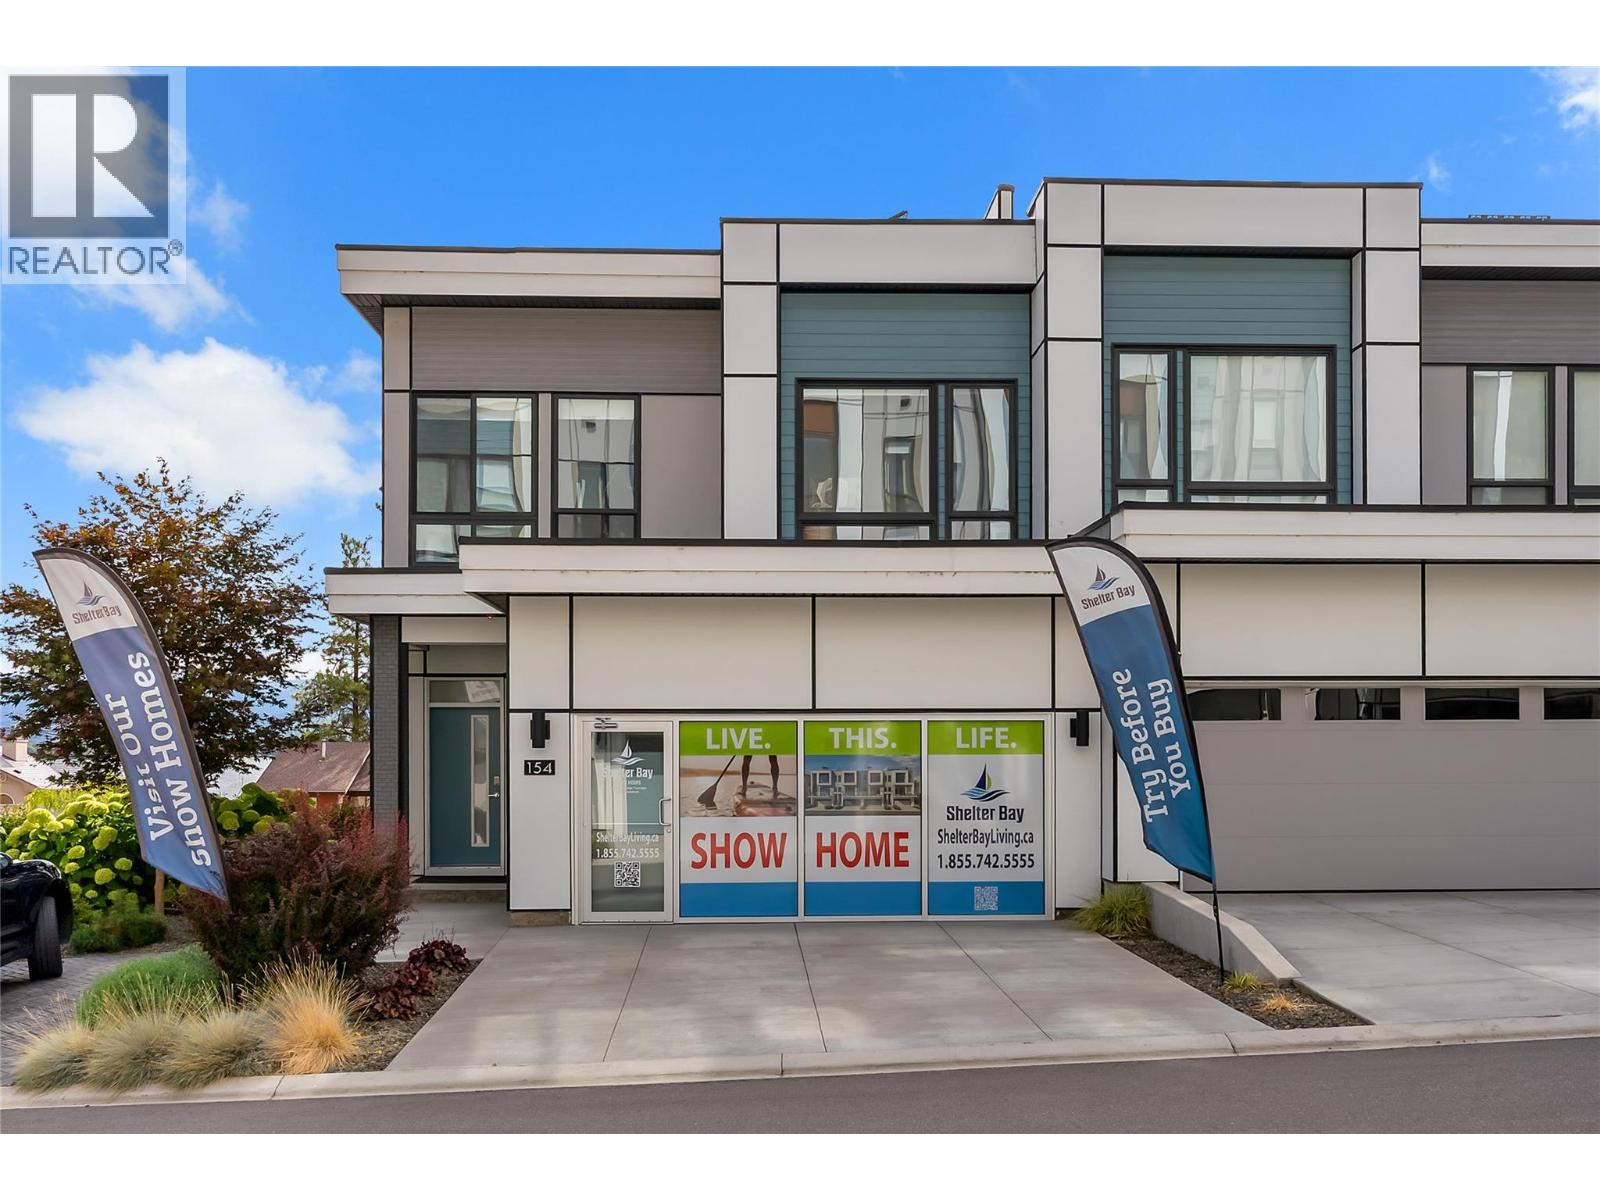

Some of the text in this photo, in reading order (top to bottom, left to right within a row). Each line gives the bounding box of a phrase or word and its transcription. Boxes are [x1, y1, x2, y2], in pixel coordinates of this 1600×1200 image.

[1081, 584, 1136, 611] Shelter Bay
[129, 652, 182, 772] Homes
[706, 728, 771, 750] LIVE.
[828, 727, 897, 749] THIS.
[956, 727, 1017, 749] LIFE.
[1112, 668, 1169, 822] Try Before
[1148, 679, 1191, 798] You Buy
[105, 693, 174, 841] Visit Our
[527, 761, 552, 774] 154
[636, 767, 653, 779] Bay
[946, 805, 1025, 823] Shelter Bay
[937, 828, 1034, 848] ShelterBayLiving.ca
[596, 847, 660, 858] 1.855.742.5555
[690, 832, 788, 870] SHOW
[816, 831, 910, 868] HOME
[937, 853, 1035, 870] 1.855.742.5555
